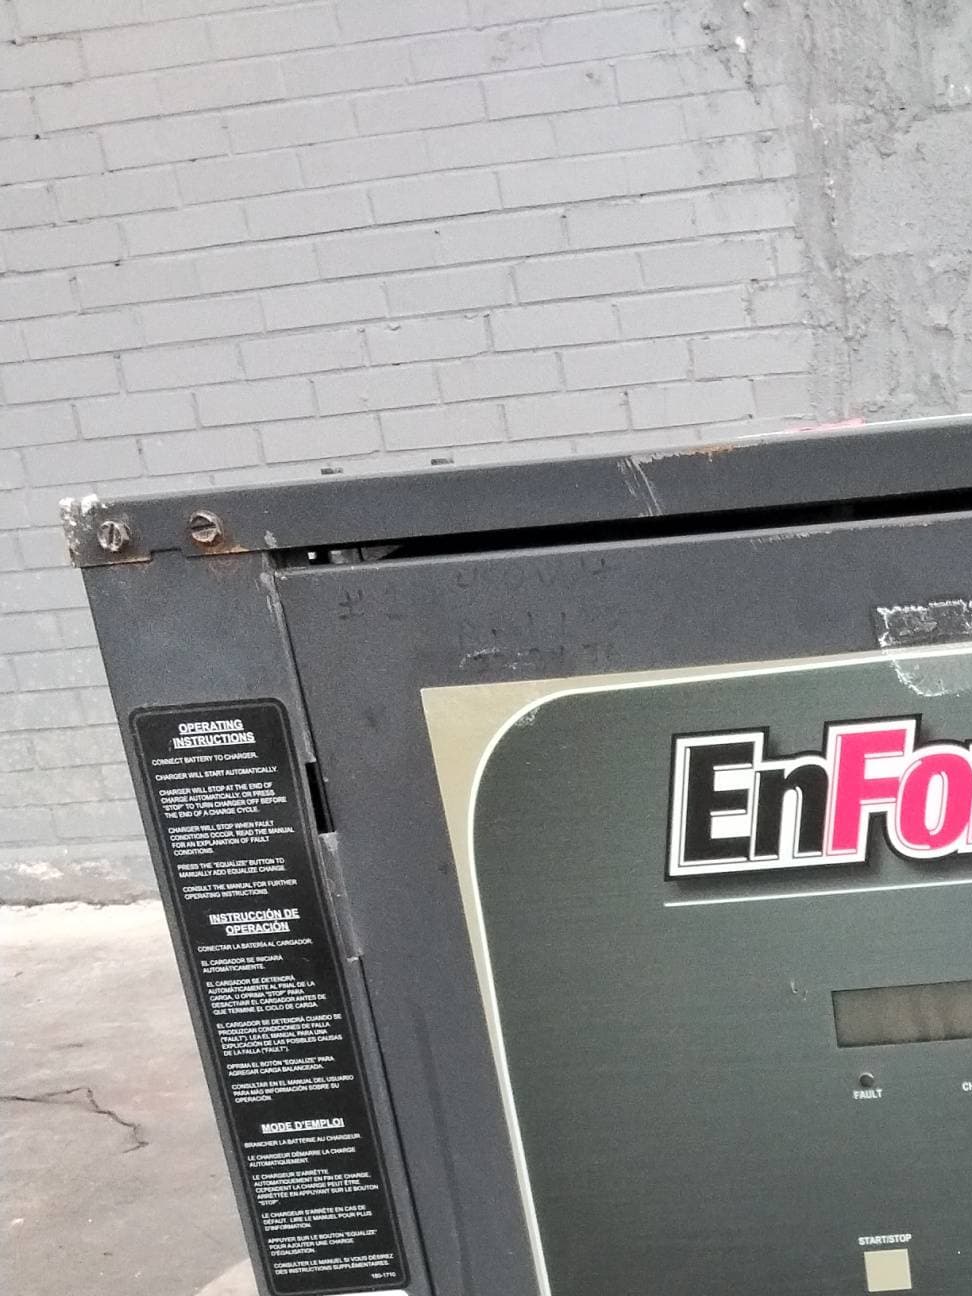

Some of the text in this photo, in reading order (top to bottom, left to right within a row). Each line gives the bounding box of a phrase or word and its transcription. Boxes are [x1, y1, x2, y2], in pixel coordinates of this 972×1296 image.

[178, 720, 244, 735] OPERATING
[172, 732, 255, 748] INSTRUCTIONS
[208, 908, 299, 925] INSTRUCCIÓN DE
[225, 920, 290, 936] OPERACIÓN
[853, 1089, 882, 1099] FAULT
[261, 1118, 344, 1134] MODE D'EMPLOI
[858, 1233, 912, 1246] START/STOP
